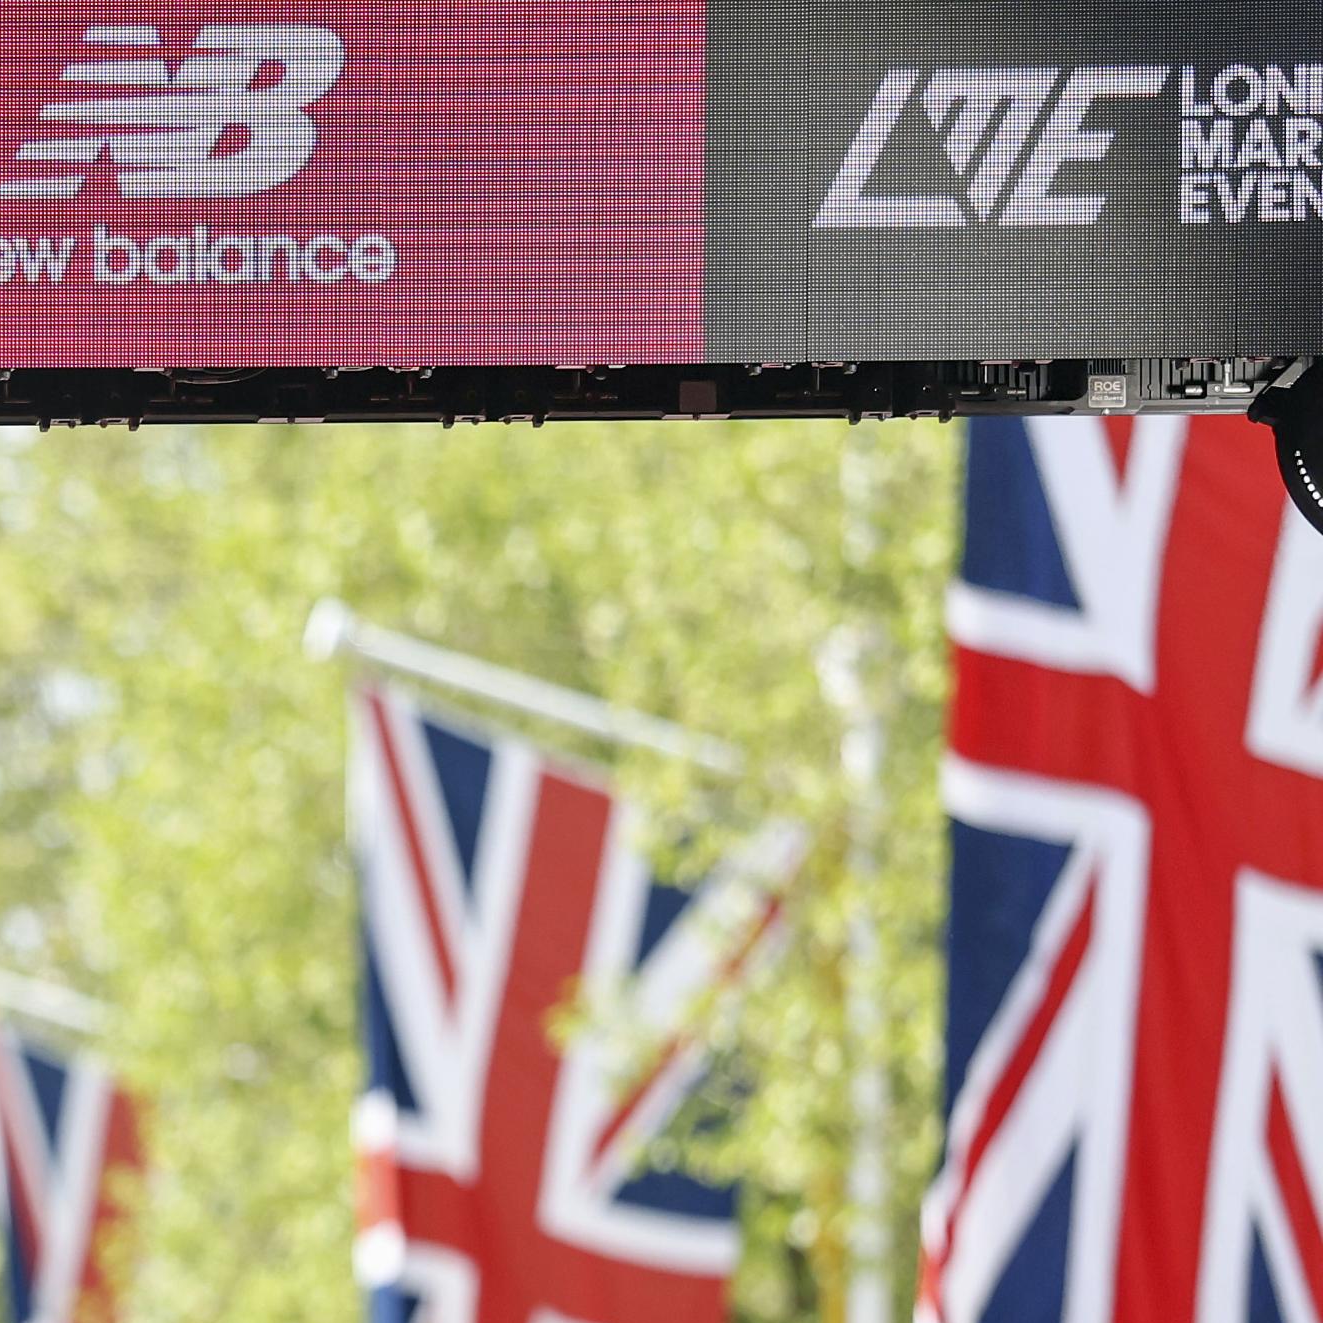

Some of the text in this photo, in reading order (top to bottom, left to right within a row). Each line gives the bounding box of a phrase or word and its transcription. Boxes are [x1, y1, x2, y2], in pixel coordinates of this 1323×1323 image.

[1180, 63, 1323, 117] LON
[92, 223, 398, 286] balance
[1093, 381, 1121, 391] ROE
